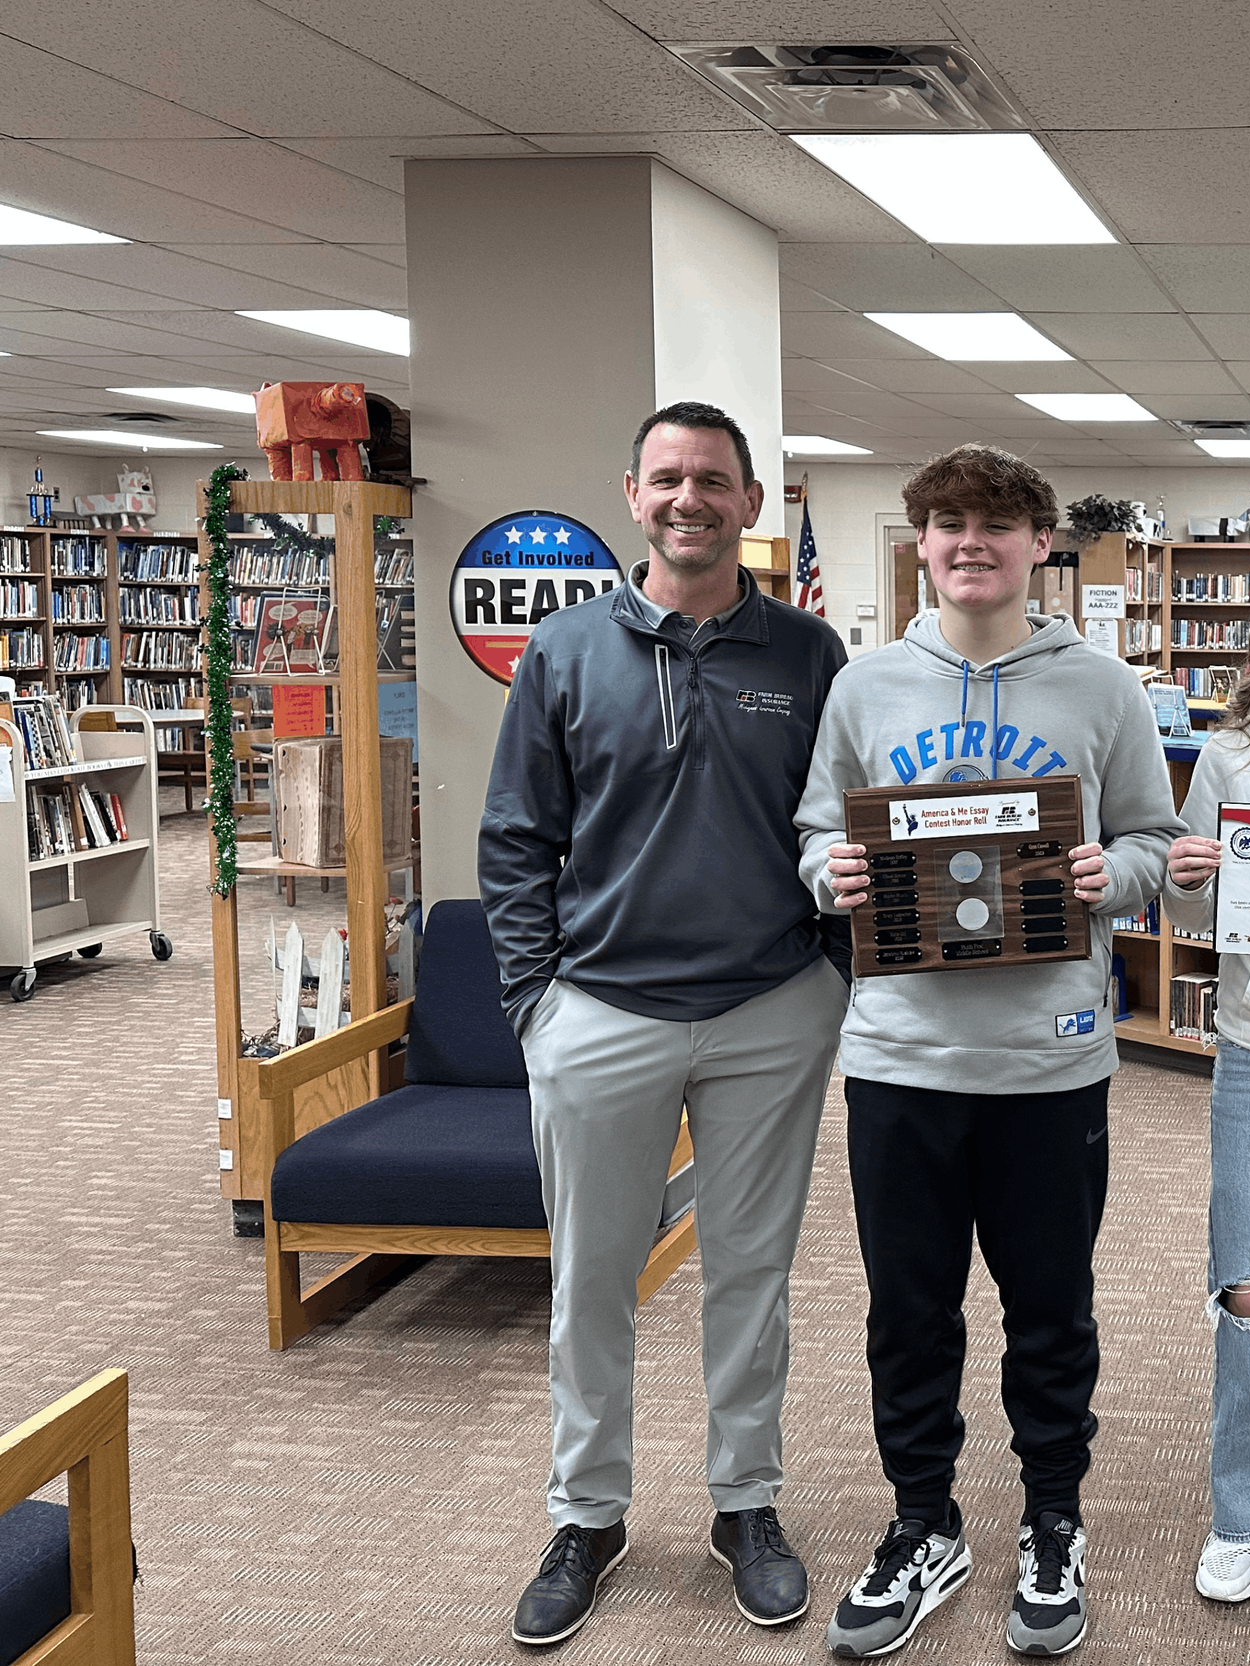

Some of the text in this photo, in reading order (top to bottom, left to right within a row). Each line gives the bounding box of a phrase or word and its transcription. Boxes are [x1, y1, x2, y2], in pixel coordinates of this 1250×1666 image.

[481, 549, 594, 566] Get Involved
[889, 721, 1067, 786] DETROIT
[921, 810, 948, 818] America
[958, 807, 968, 816] Me
[970, 806, 989, 816] Essay
[924, 816, 987, 828] Contest Honor Roll
